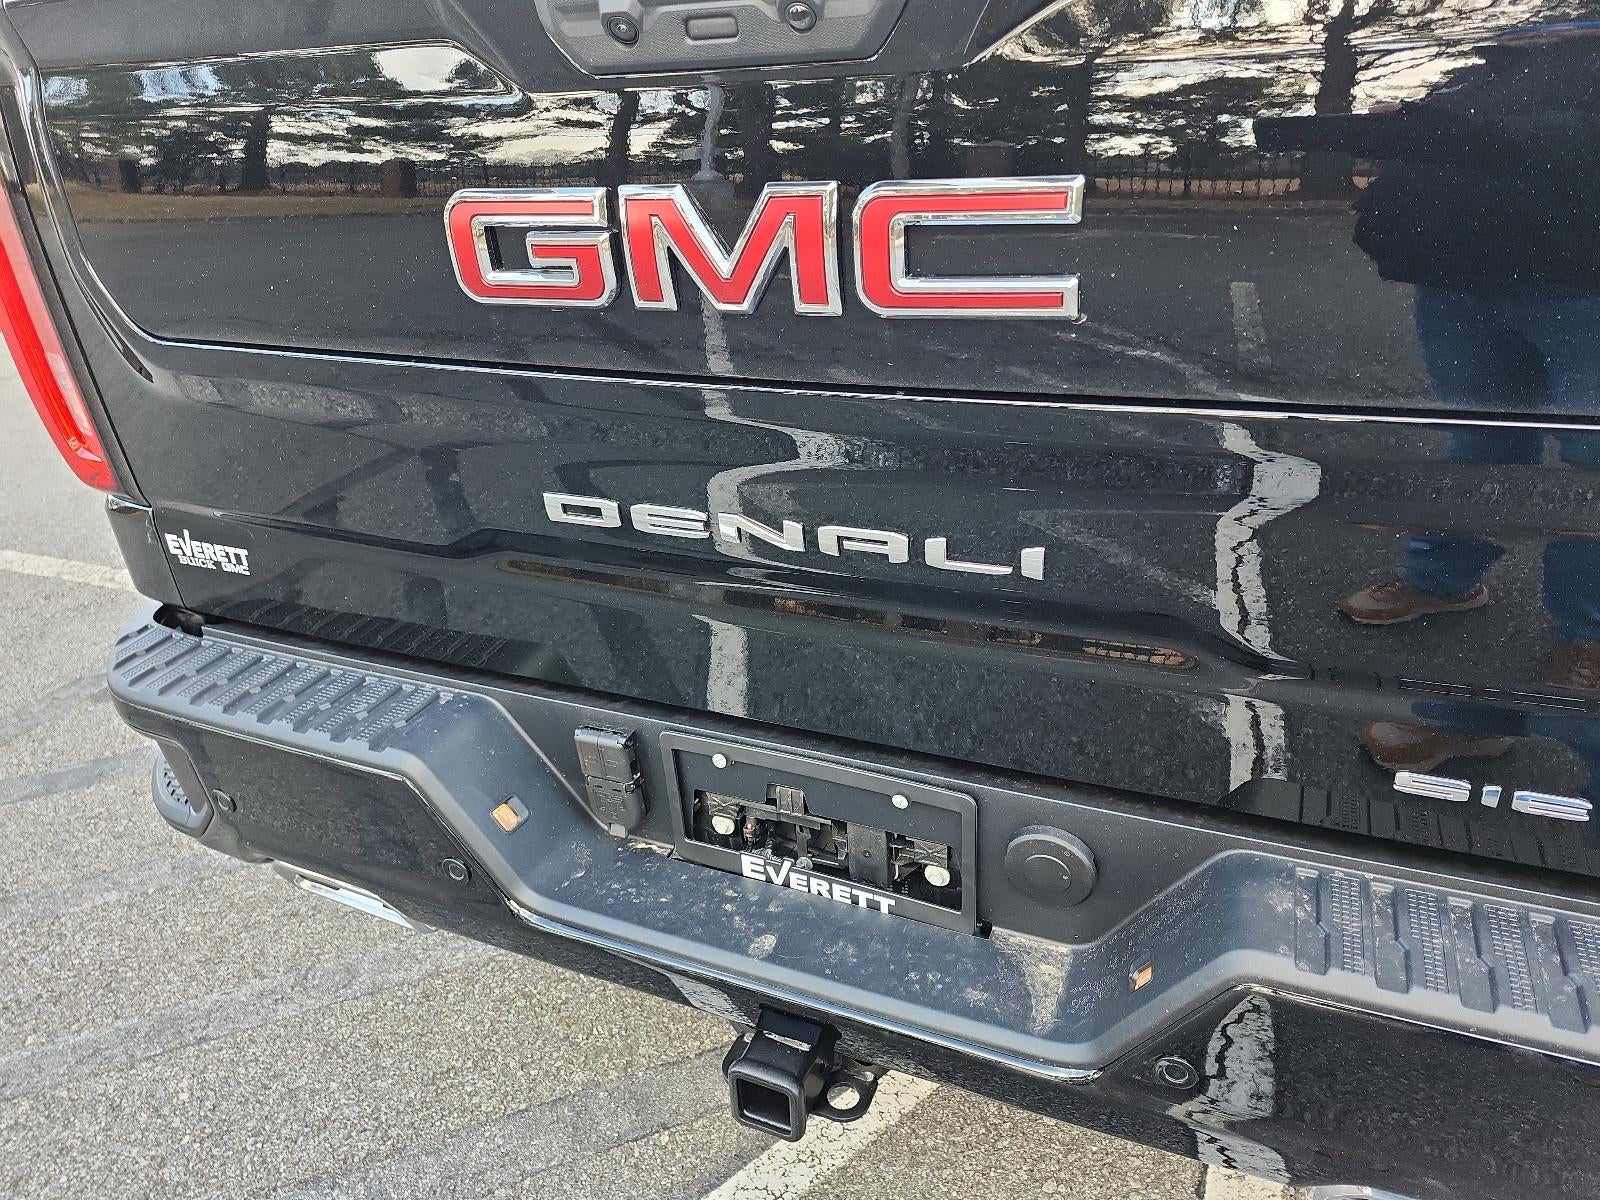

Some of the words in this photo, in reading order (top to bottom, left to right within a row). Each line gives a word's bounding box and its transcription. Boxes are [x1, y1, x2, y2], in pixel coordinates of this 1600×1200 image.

[444, 174, 1085, 320] GMC
[164, 528, 249, 567] EVERETT
[178, 554, 217, 570] BUICK
[221, 562, 251, 576] GMC
[542, 492, 1046, 581] DENALI
[740, 852, 896, 915] EVERETT
